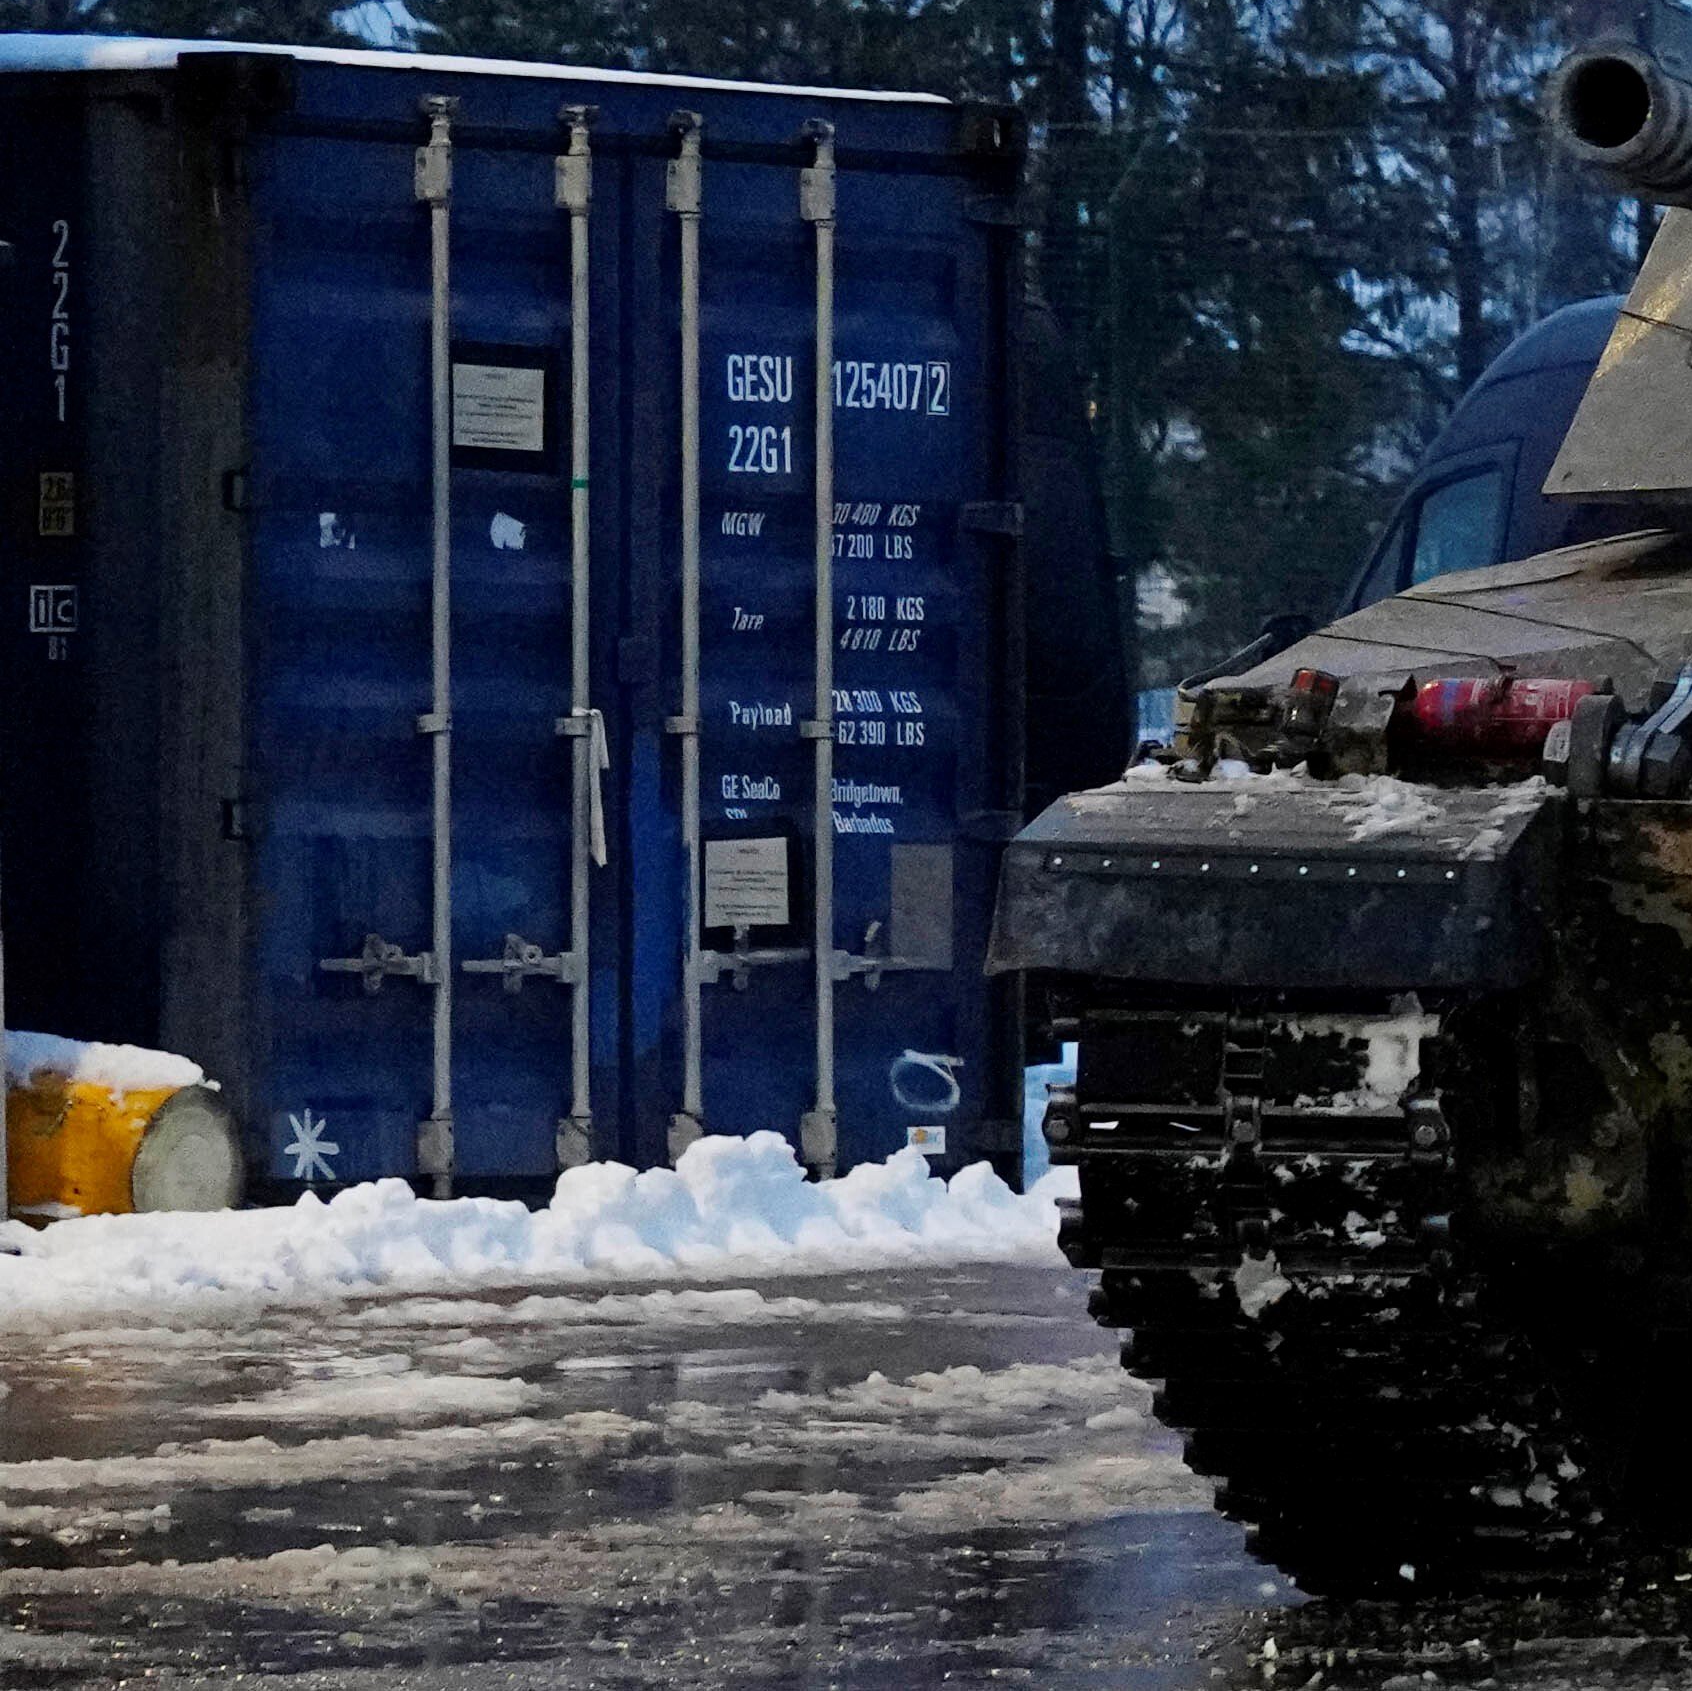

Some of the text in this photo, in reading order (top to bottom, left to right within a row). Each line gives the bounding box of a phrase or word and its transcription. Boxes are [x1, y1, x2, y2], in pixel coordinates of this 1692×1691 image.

[52, 219, 69, 422] 22G1
[727, 354, 793, 403] GESU
[728, 425, 792, 474] 22G1
[722, 511, 766, 537] MGW
[887, 503, 921, 527] KGS
[885, 534, 913, 560] LBS
[732, 607, 765, 632] Tare
[896, 595, 925, 622] KGS
[887, 628, 921, 652] LBS
[729, 700, 793, 731] Payload
[888, 690, 923, 714] KGS
[896, 721, 925, 747] LBS
[721, 774, 740, 800] GE
[832, 810, 895, 834] Barbados
